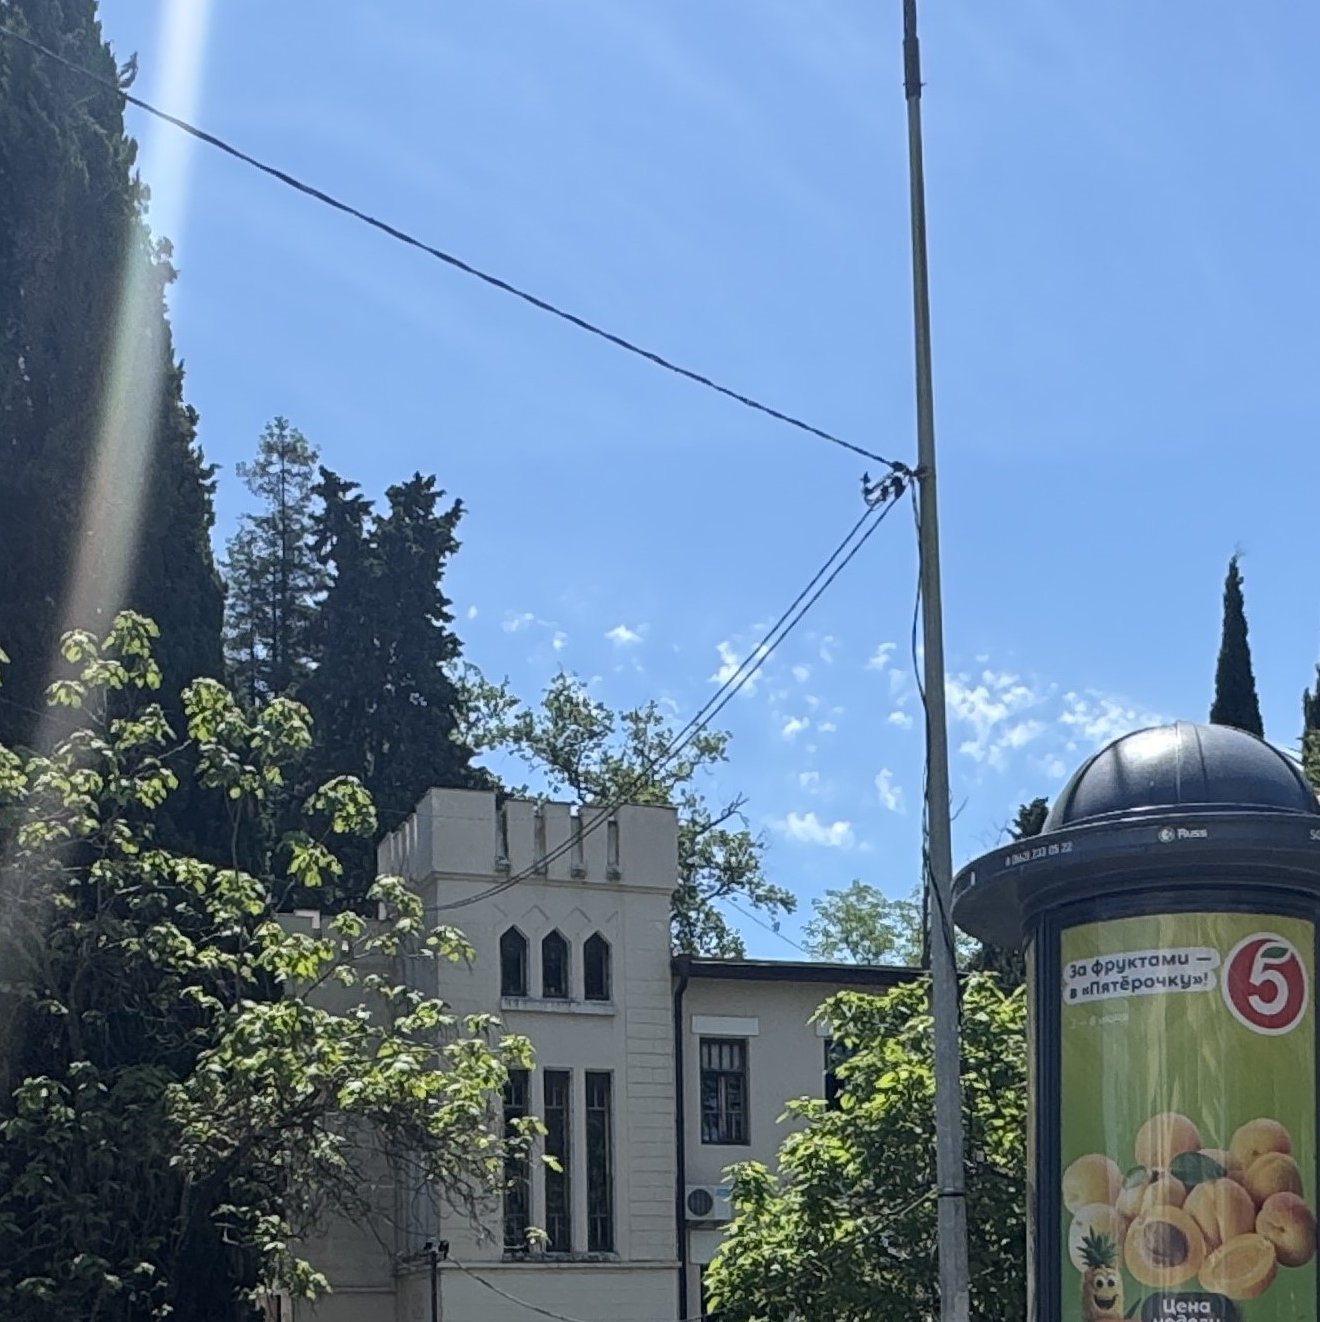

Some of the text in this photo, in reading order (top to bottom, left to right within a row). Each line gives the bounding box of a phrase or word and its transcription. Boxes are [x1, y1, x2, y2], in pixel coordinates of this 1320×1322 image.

[1069, 964, 1087, 979] За
[1091, 953, 1190, 977] фруктами
[1248, 942, 1292, 1016] 5
[1069, 972, 1209, 999] в «Пятёрочку»!
[1162, 1299, 1212, 1316] Цена
